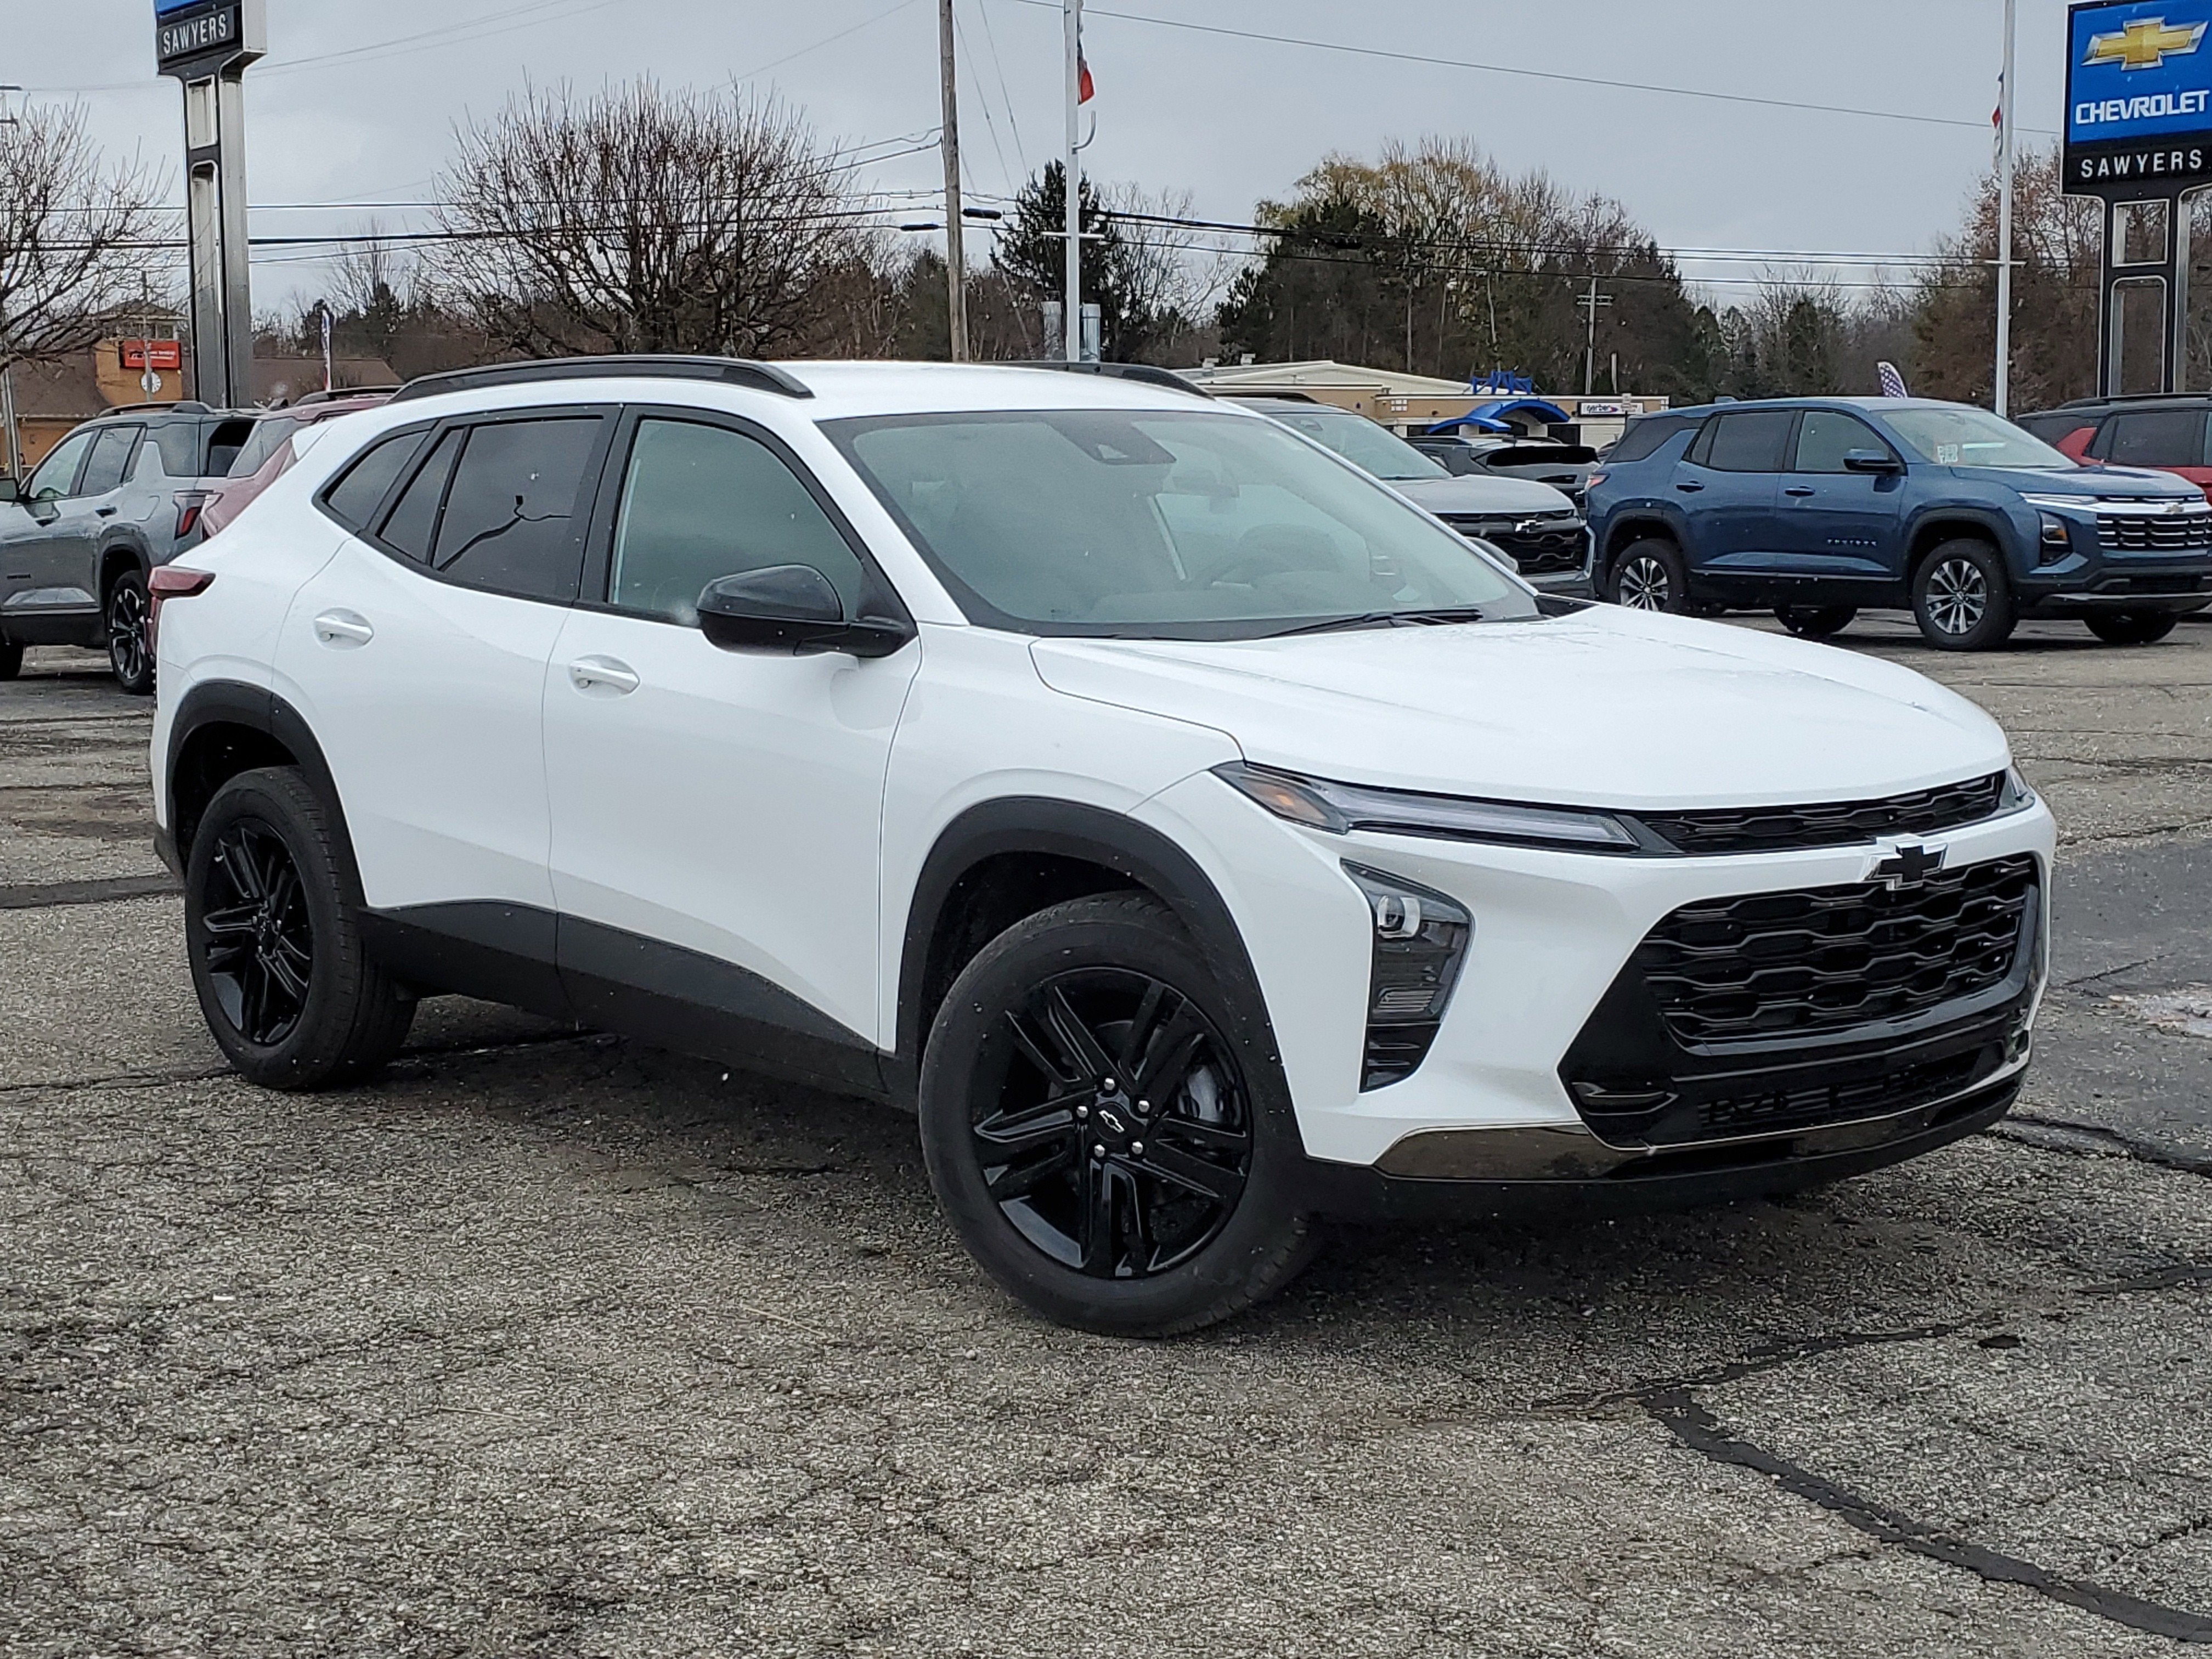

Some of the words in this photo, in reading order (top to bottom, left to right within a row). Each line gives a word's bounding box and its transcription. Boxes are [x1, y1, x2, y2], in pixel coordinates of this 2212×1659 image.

[163, 13, 227, 54] SAWYERS
[2075, 89, 2210, 125] CHEVROLET
[2081, 149, 2203, 178] SAWYERS
